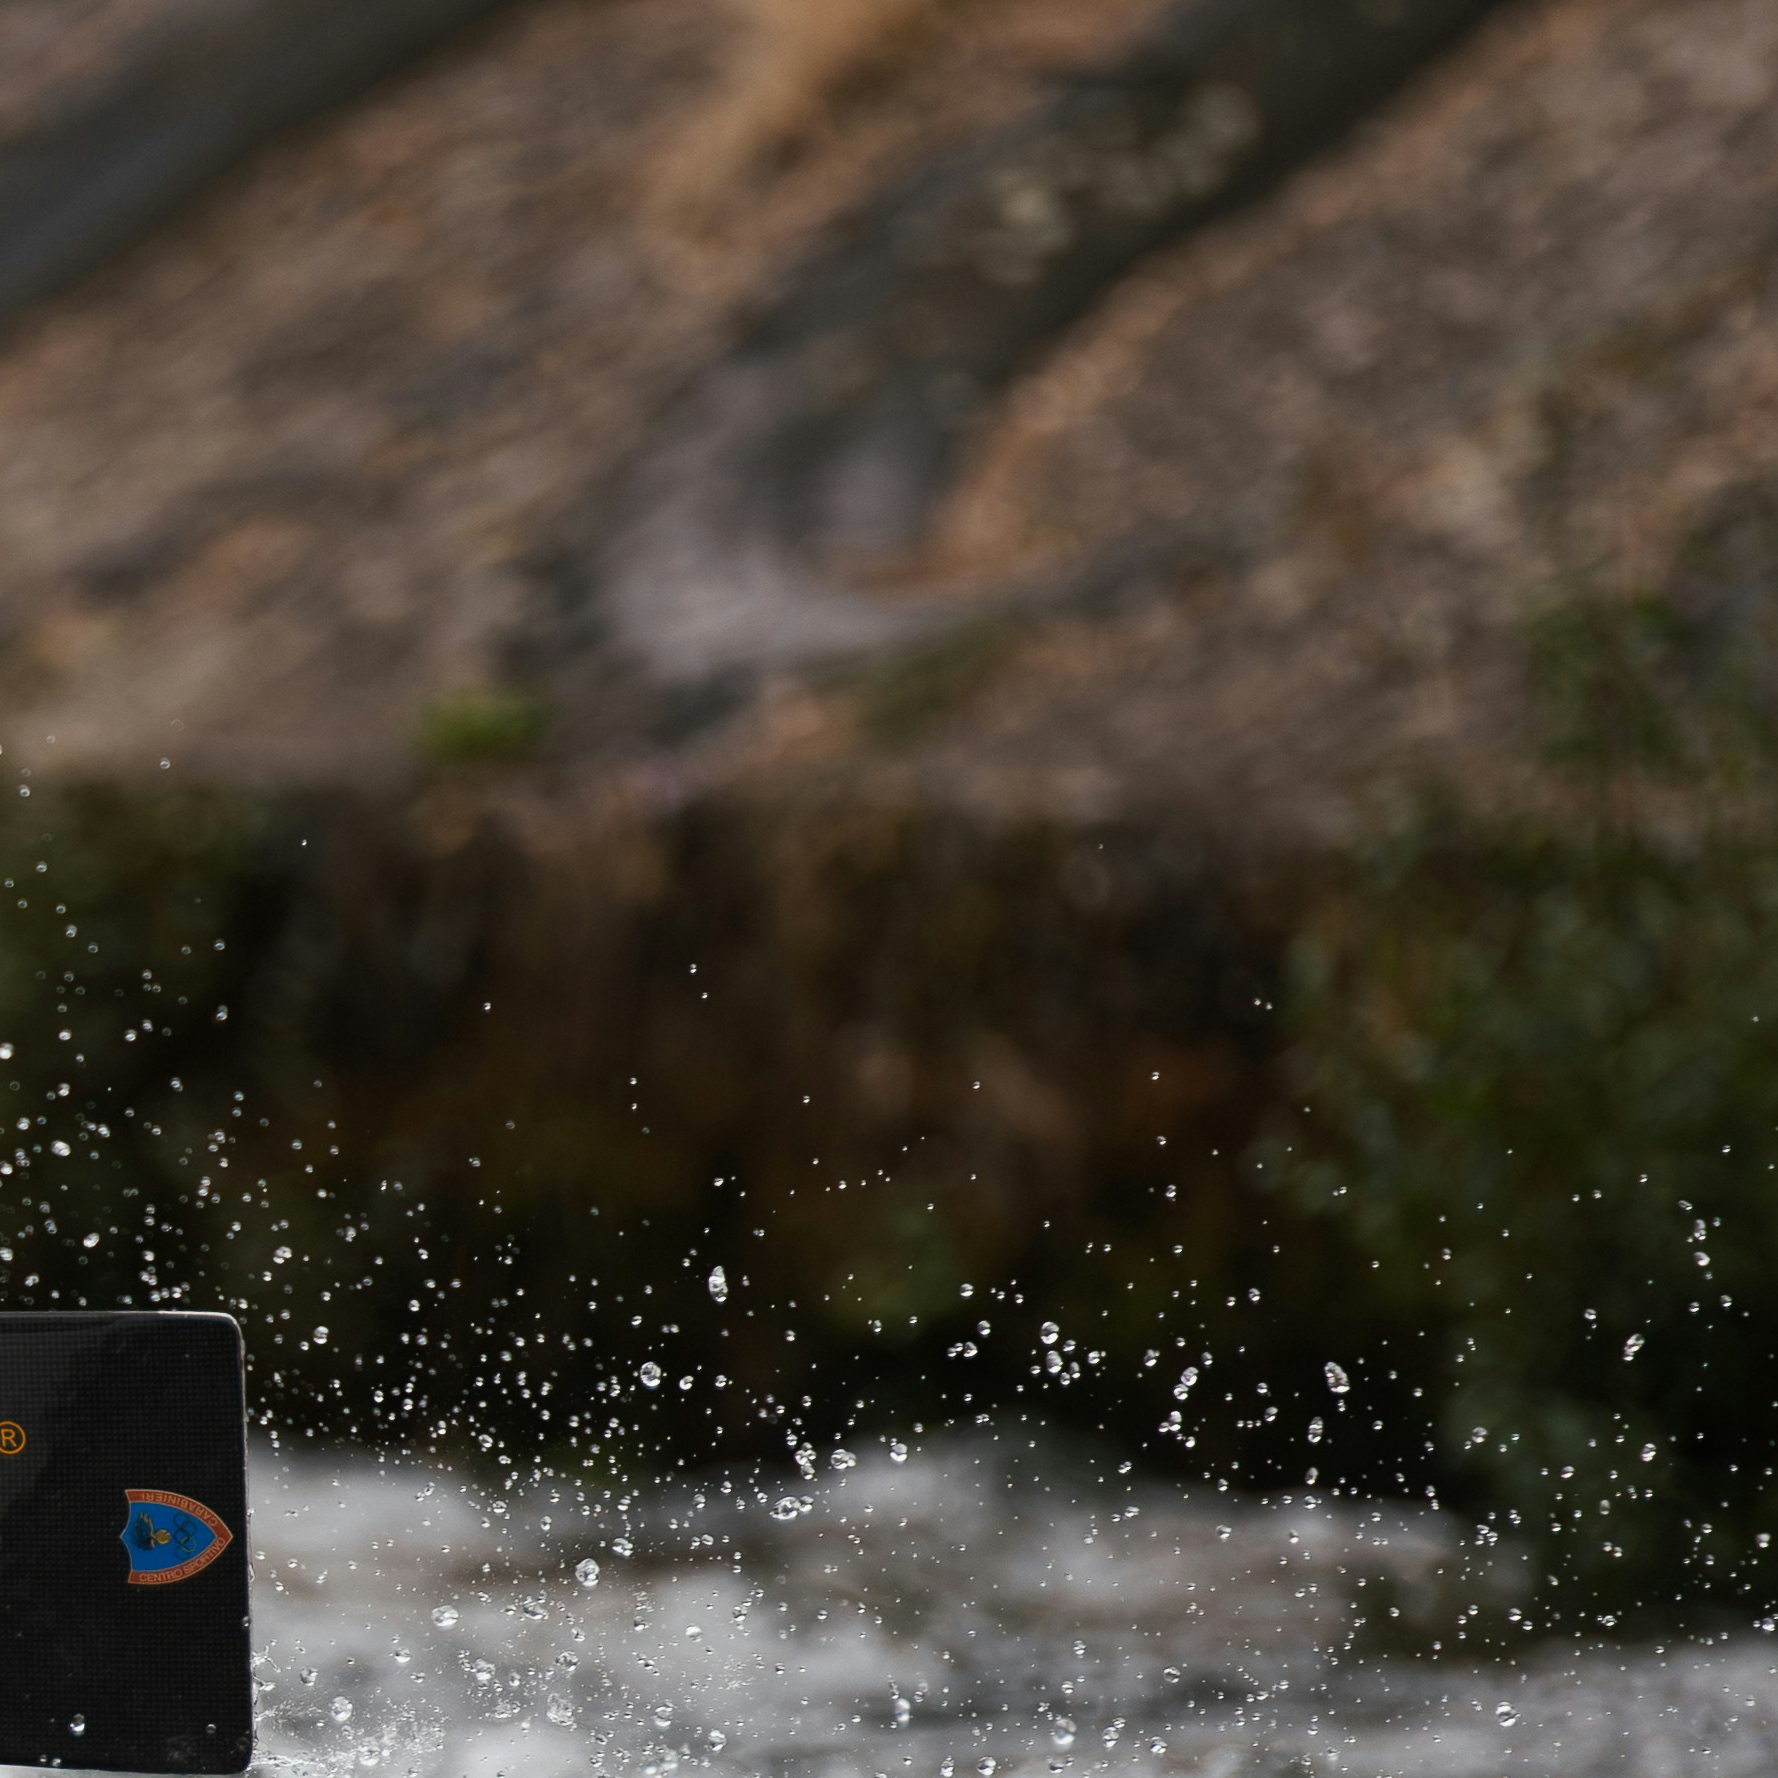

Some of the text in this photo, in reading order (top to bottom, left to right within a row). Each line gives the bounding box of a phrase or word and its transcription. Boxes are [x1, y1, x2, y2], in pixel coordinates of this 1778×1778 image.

[141, 1492, 219, 1527] CARABINIERI
[139, 1536, 226, 1582] CENTRO SPORTIVO
